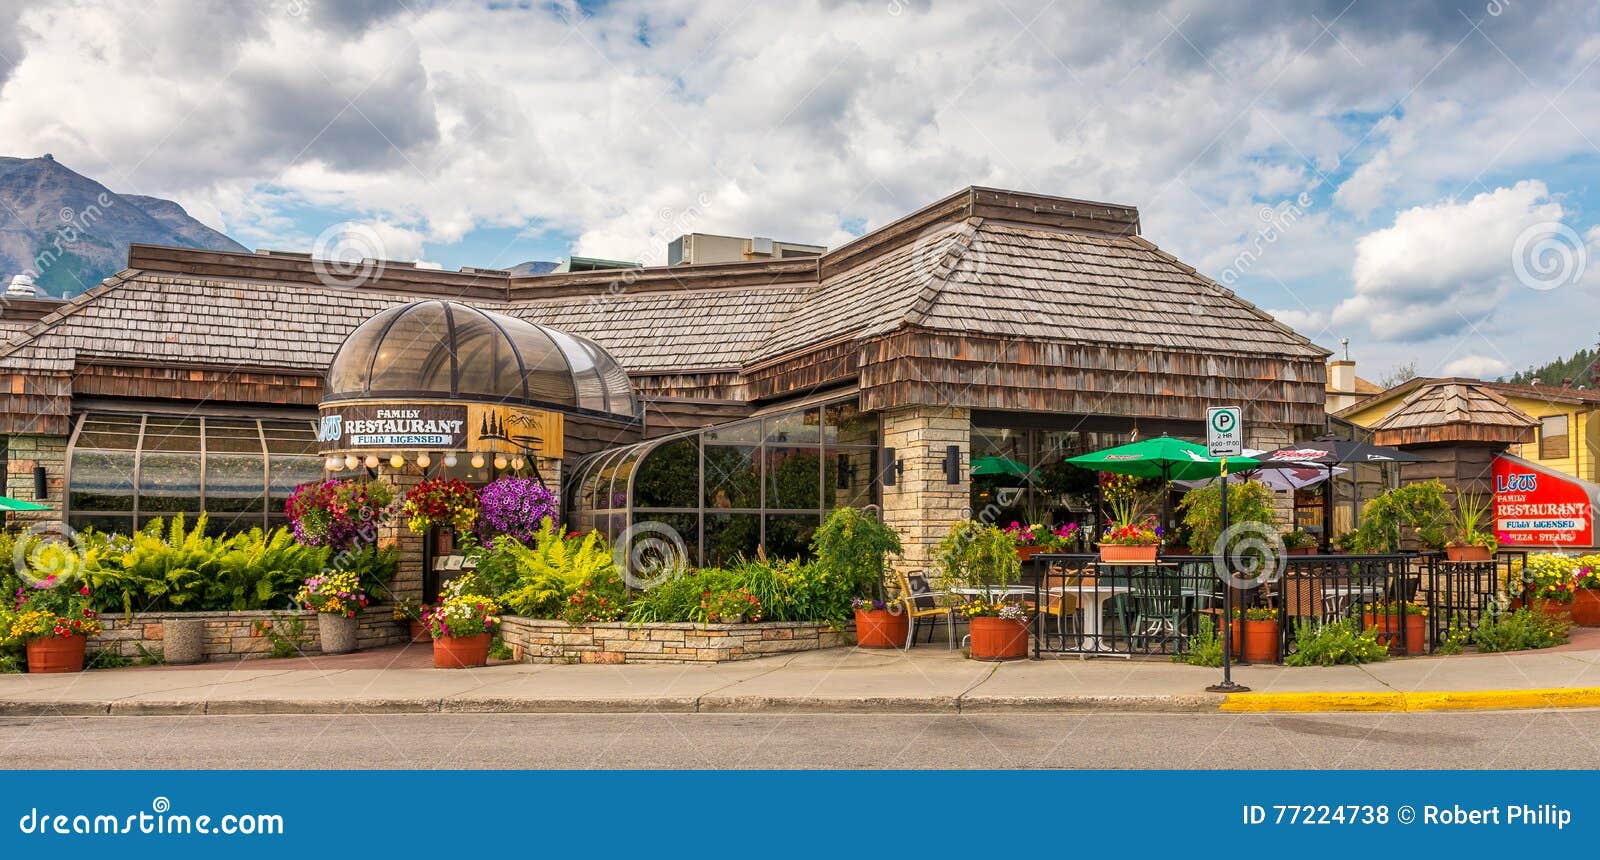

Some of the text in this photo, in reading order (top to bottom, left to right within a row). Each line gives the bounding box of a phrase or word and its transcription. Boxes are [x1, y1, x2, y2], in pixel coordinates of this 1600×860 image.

[376, 409, 420, 419] FAMILY
[1220, 415, 1230, 427] P
[345, 420, 464, 434] RESTAURANT
[358, 435, 443, 444] FULLY LICENSED
[1497, 474, 1537, 493] L&W
[1497, 494, 1527, 502] FAMILY
[1497, 503, 1586, 516] RESTAURANT
[1506, 520, 1576, 529] FULLY LICENSED
[1509, 533, 1533, 541] PIZZA
